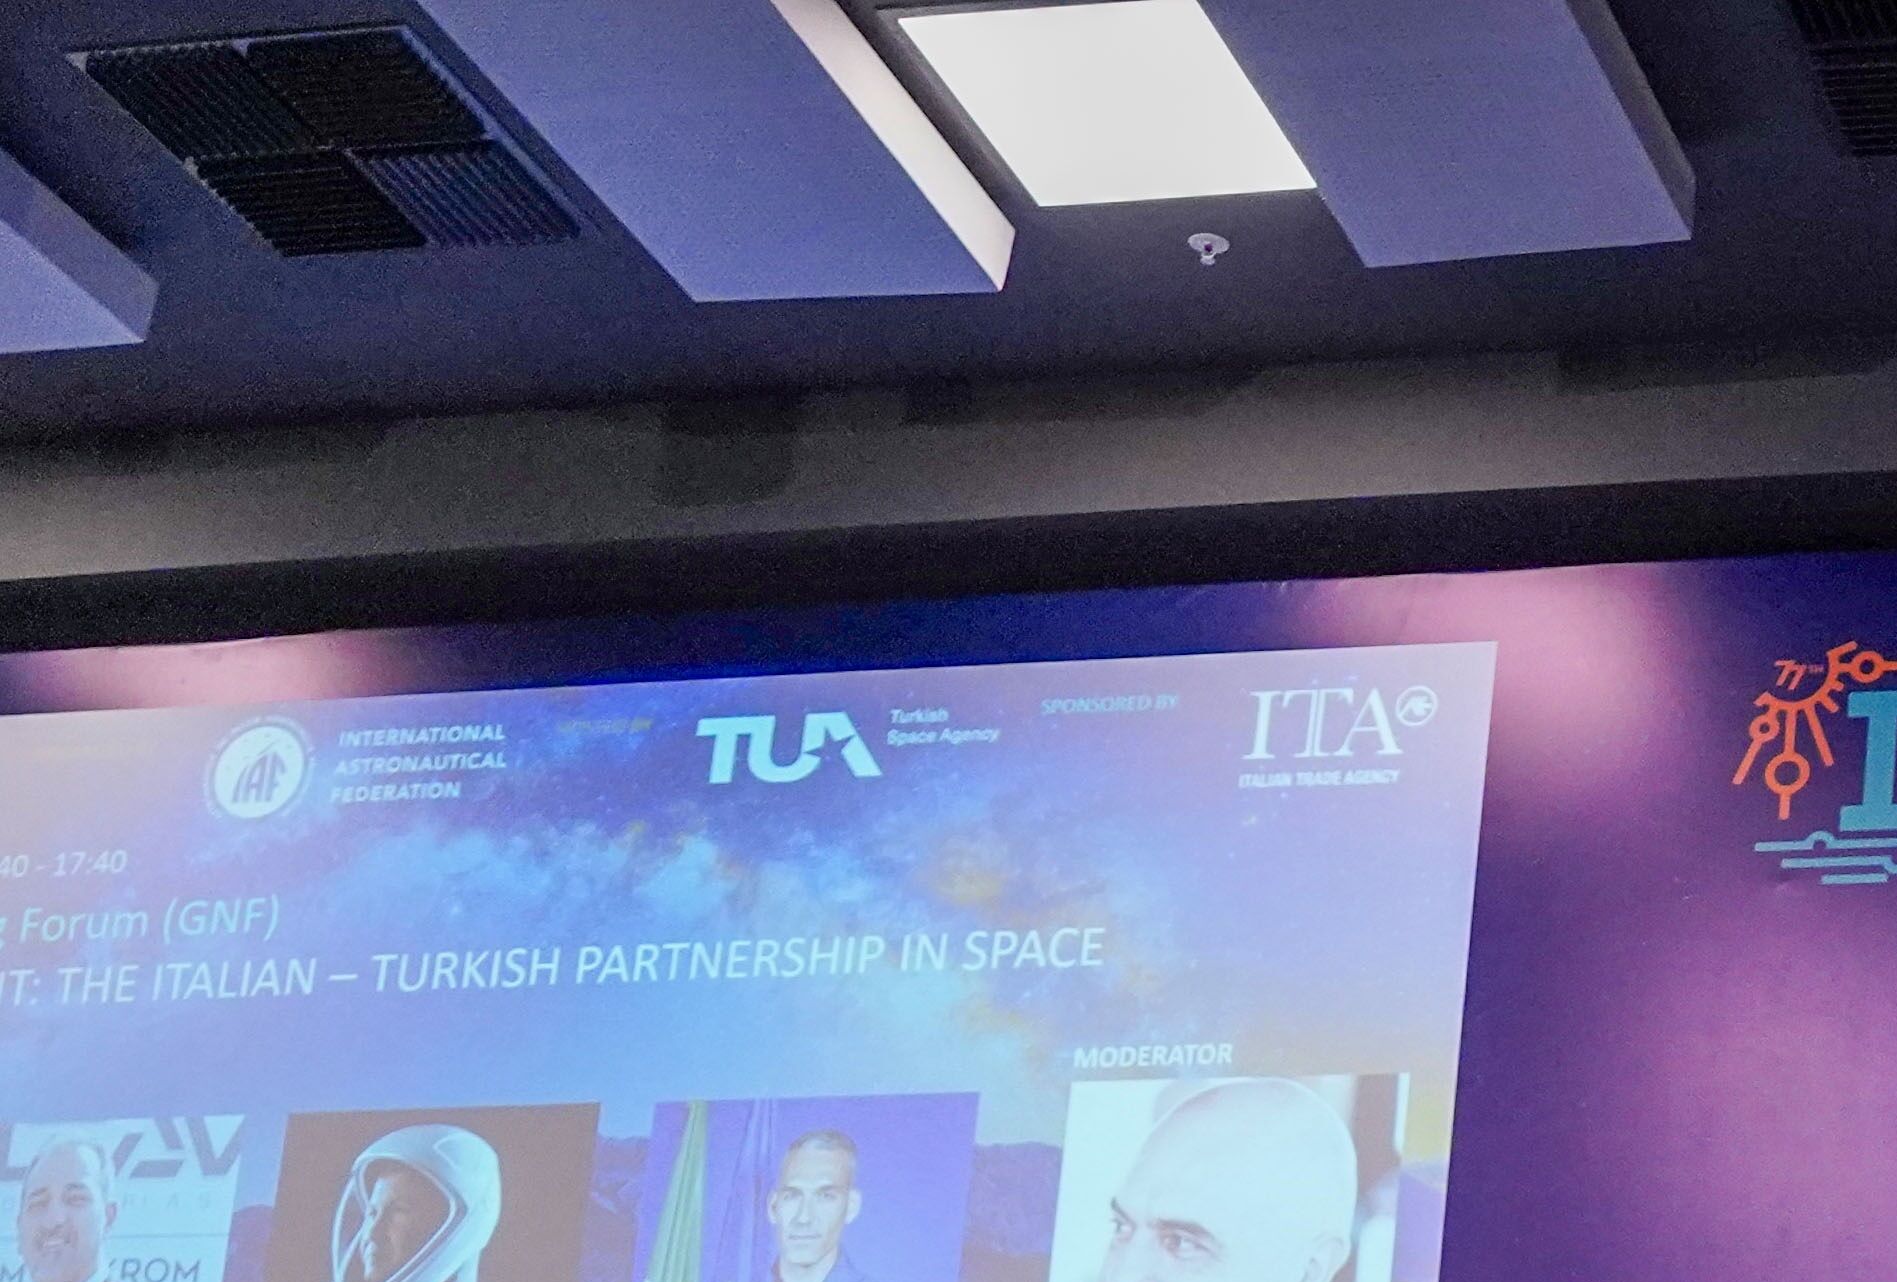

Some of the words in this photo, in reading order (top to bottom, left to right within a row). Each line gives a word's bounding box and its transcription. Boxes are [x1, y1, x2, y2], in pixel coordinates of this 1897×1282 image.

[338, 725, 506, 746] INTERNATIONAL
[1241, 687, 1403, 760] ITA
[695, 711, 883, 784] TUA
[334, 753, 506, 775] ASTRONAUTICAL
[330, 782, 461, 803] FEDERATION
[53, 850, 128, 877] 17:40
[19, 907, 148, 942] Forum
[163, 894, 280, 944] (GNF)
[58, 964, 139, 1004] THE
[152, 958, 317, 1000] ITALIAN
[372, 947, 560, 992] TURKISH
[576, 935, 885, 984] PARTNERSHIP
[901, 933, 949, 972] IN
[962, 927, 1106, 971] SPACE
[1073, 1043, 1233, 1069] MODERATOR
